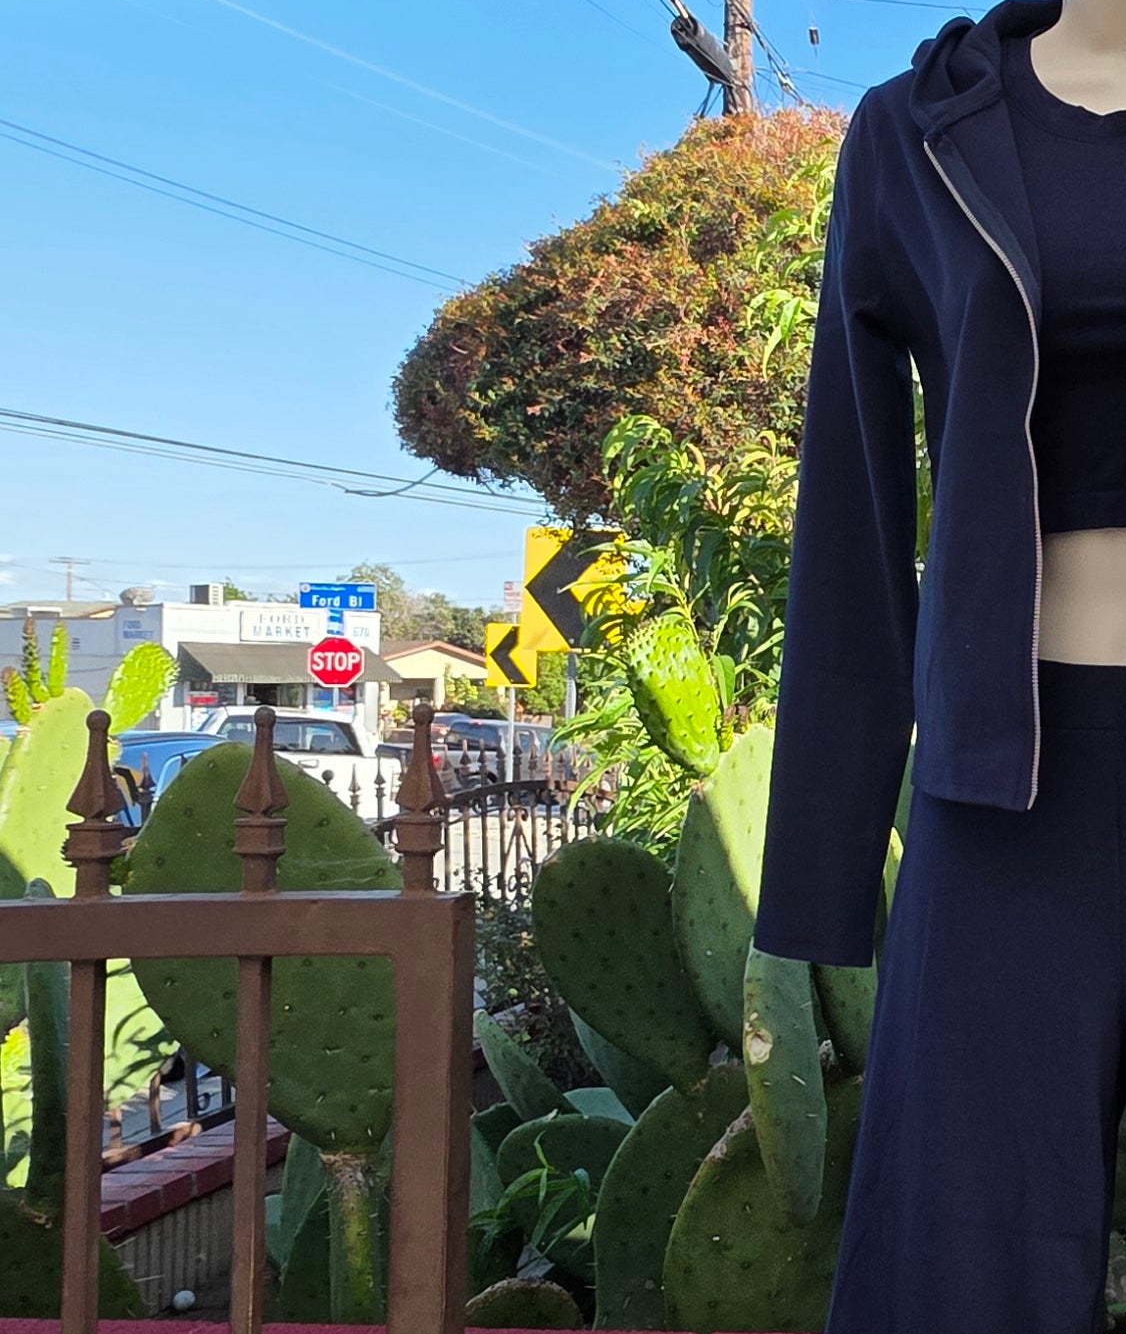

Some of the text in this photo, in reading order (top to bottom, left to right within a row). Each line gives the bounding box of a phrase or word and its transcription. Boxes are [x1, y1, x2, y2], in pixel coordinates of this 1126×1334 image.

[312, 594, 341, 607] Ford
[252, 625, 311, 638] MARKET
[312, 651, 361, 672] STOP
